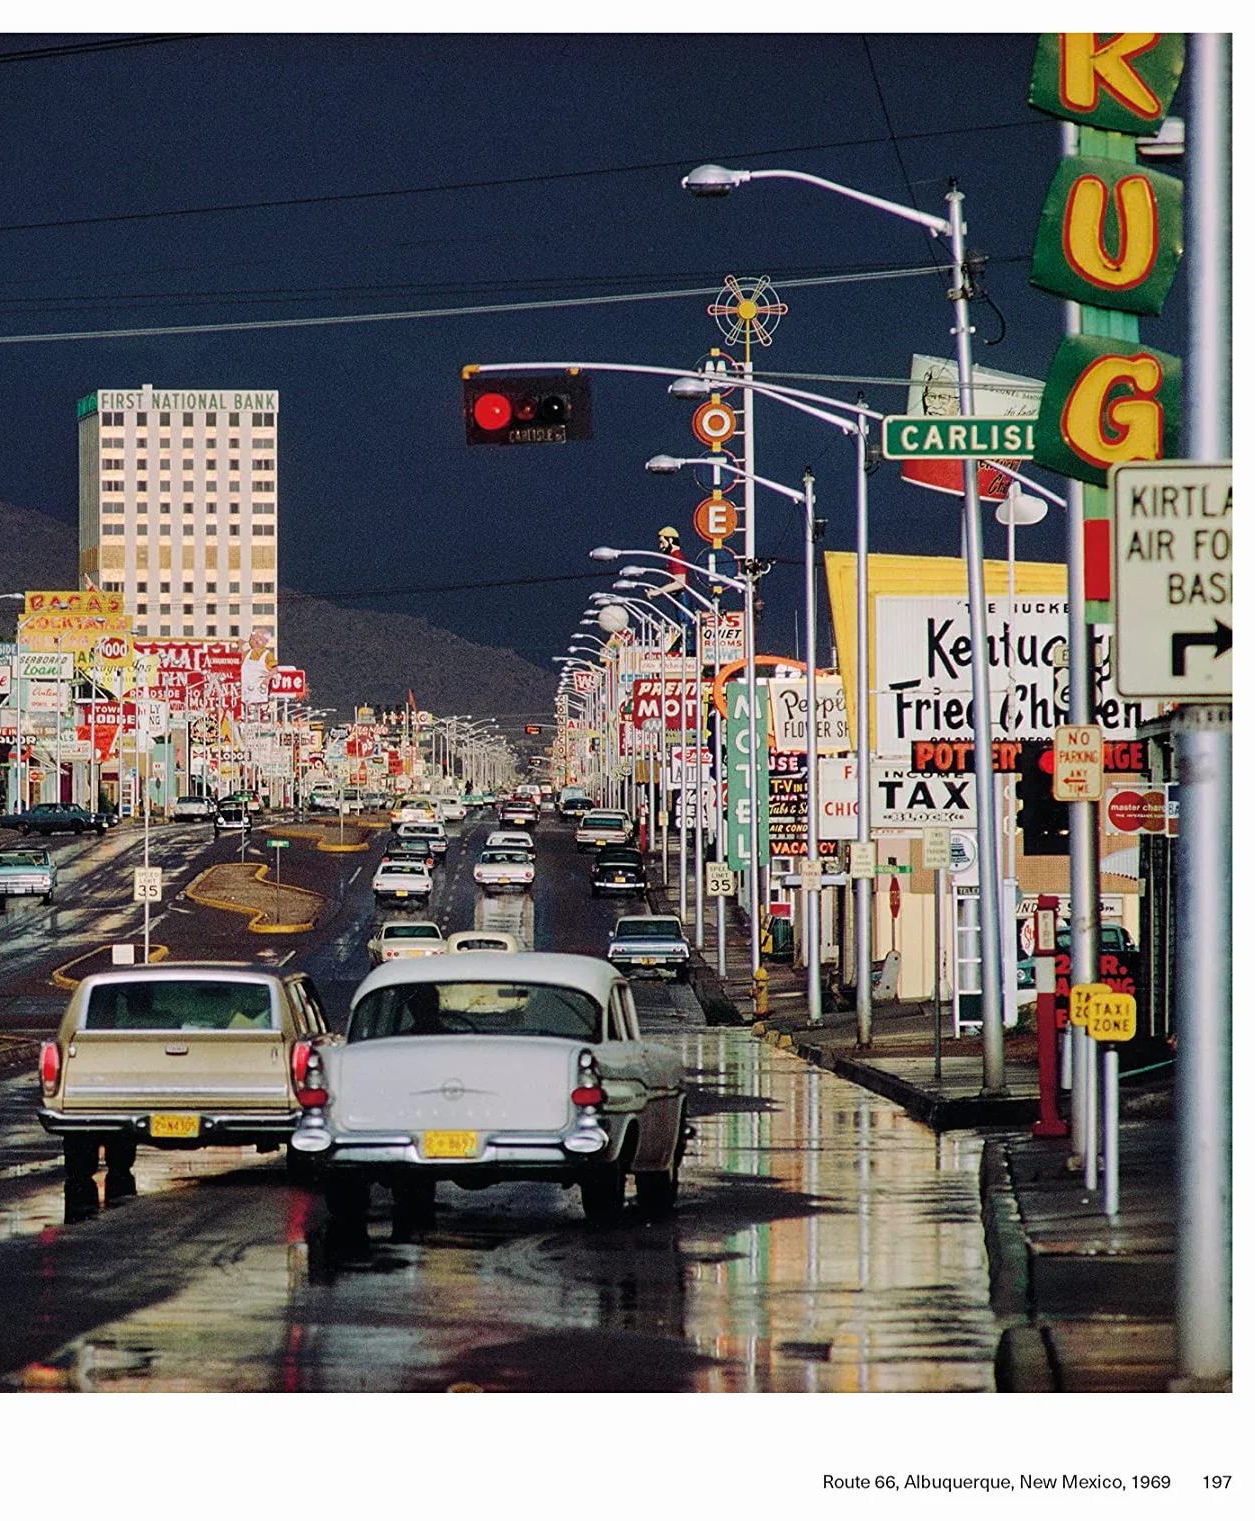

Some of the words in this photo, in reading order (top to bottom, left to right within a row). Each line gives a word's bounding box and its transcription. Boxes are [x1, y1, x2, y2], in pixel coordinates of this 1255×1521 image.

[101, 392, 144, 410] FIRST
[152, 392, 227, 410] NATIONAL
[234, 392, 276, 411] BANK
[1127, 529, 1175, 561] AIR
[1067, 732, 1091, 745] NO
[1058, 750, 1099, 763] PARKING
[884, 771, 965, 779] INCOME
[1069, 770, 1088, 778] ANY
[878, 781, 970, 810] TAX
[771, 842, 837, 854] VACACY
[137, 885, 159, 897] 35
[711, 879, 731, 892] 35
[1095, 1003, 1131, 1015] TAXI
[1093, 1019, 1130, 1032] ZONE
